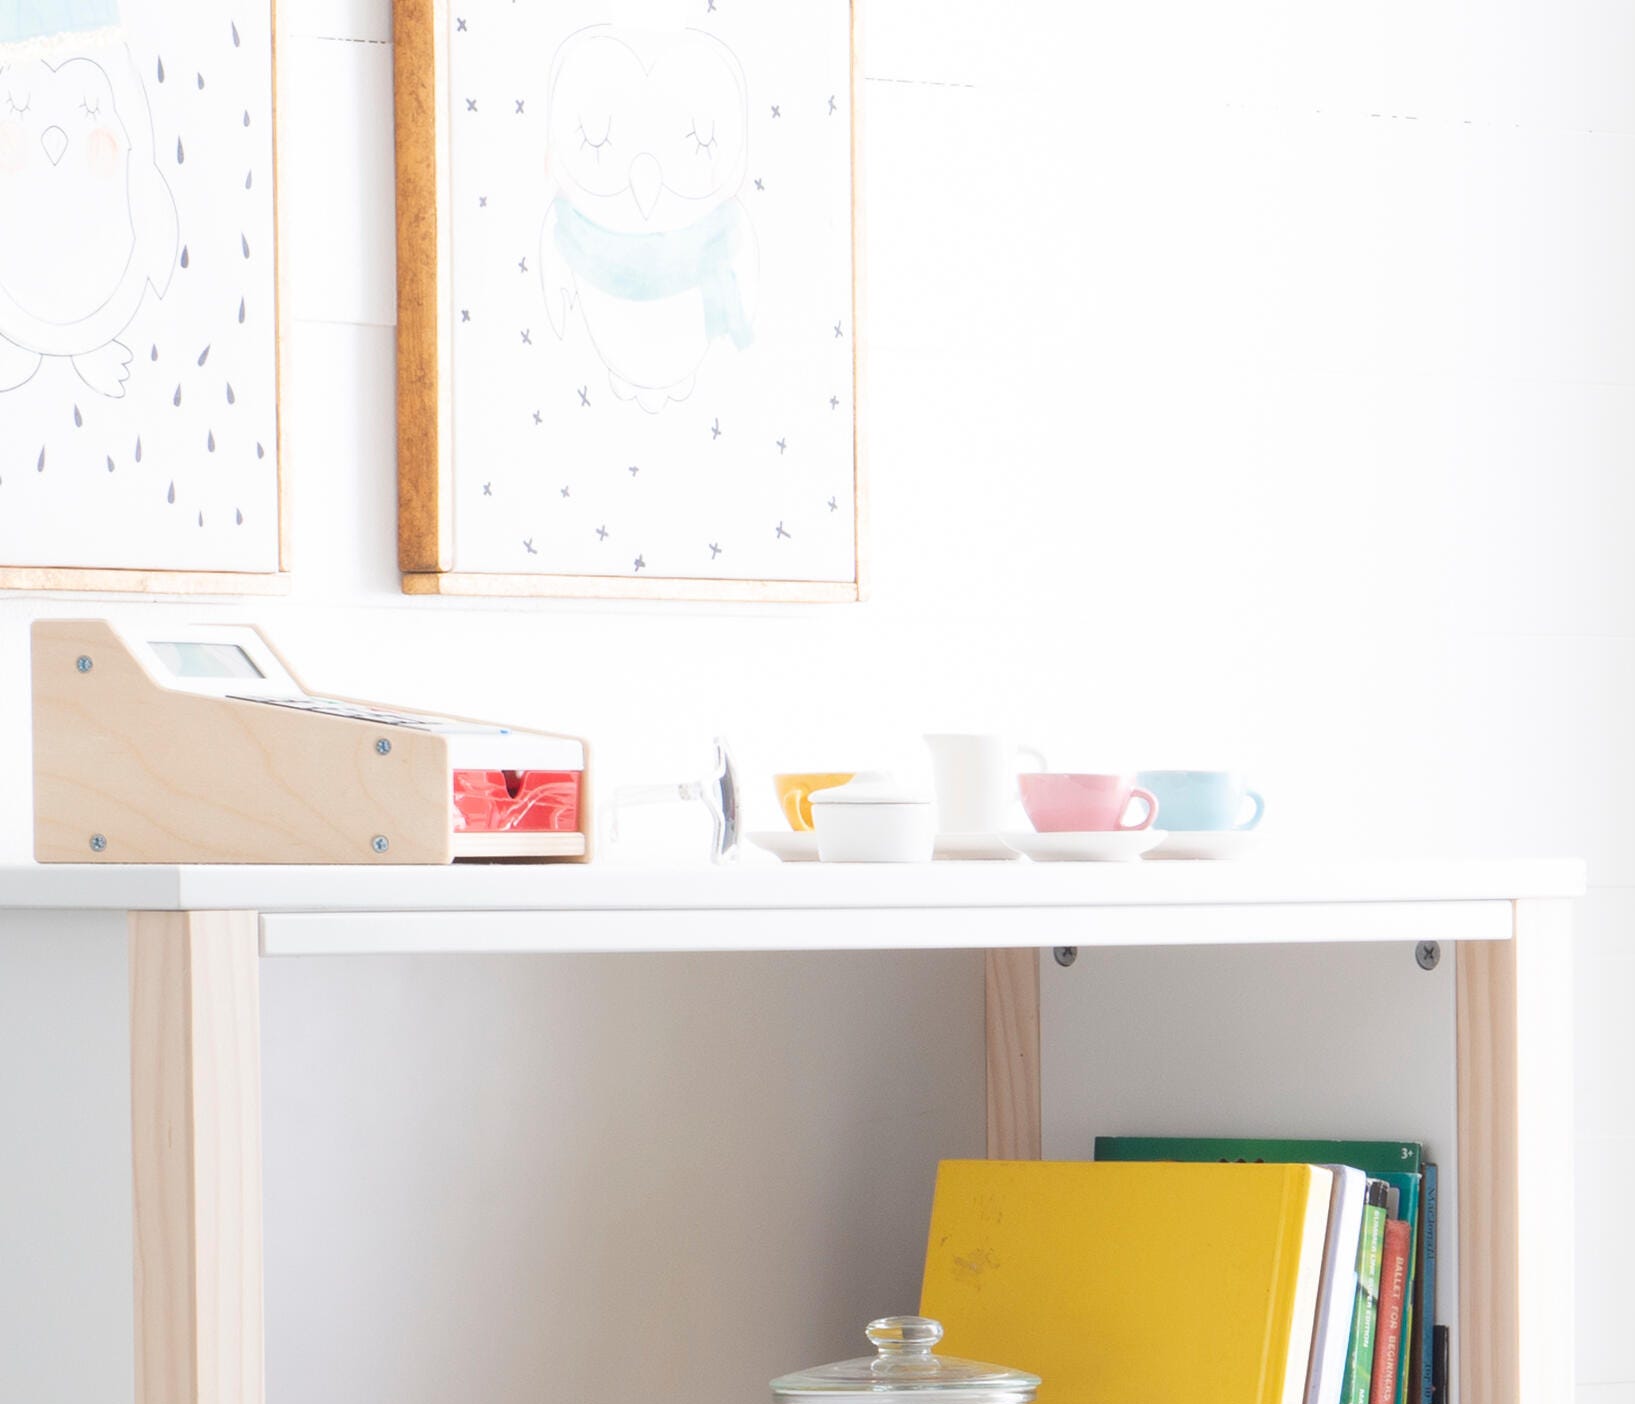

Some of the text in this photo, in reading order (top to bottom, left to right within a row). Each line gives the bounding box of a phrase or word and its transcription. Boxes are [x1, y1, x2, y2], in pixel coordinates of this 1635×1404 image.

[1401, 1148, 1413, 1159] 3+
[1362, 1309, 1370, 1347] EDITION
[1384, 1257, 1404, 1401] BALLET FOR BEGINNERS
